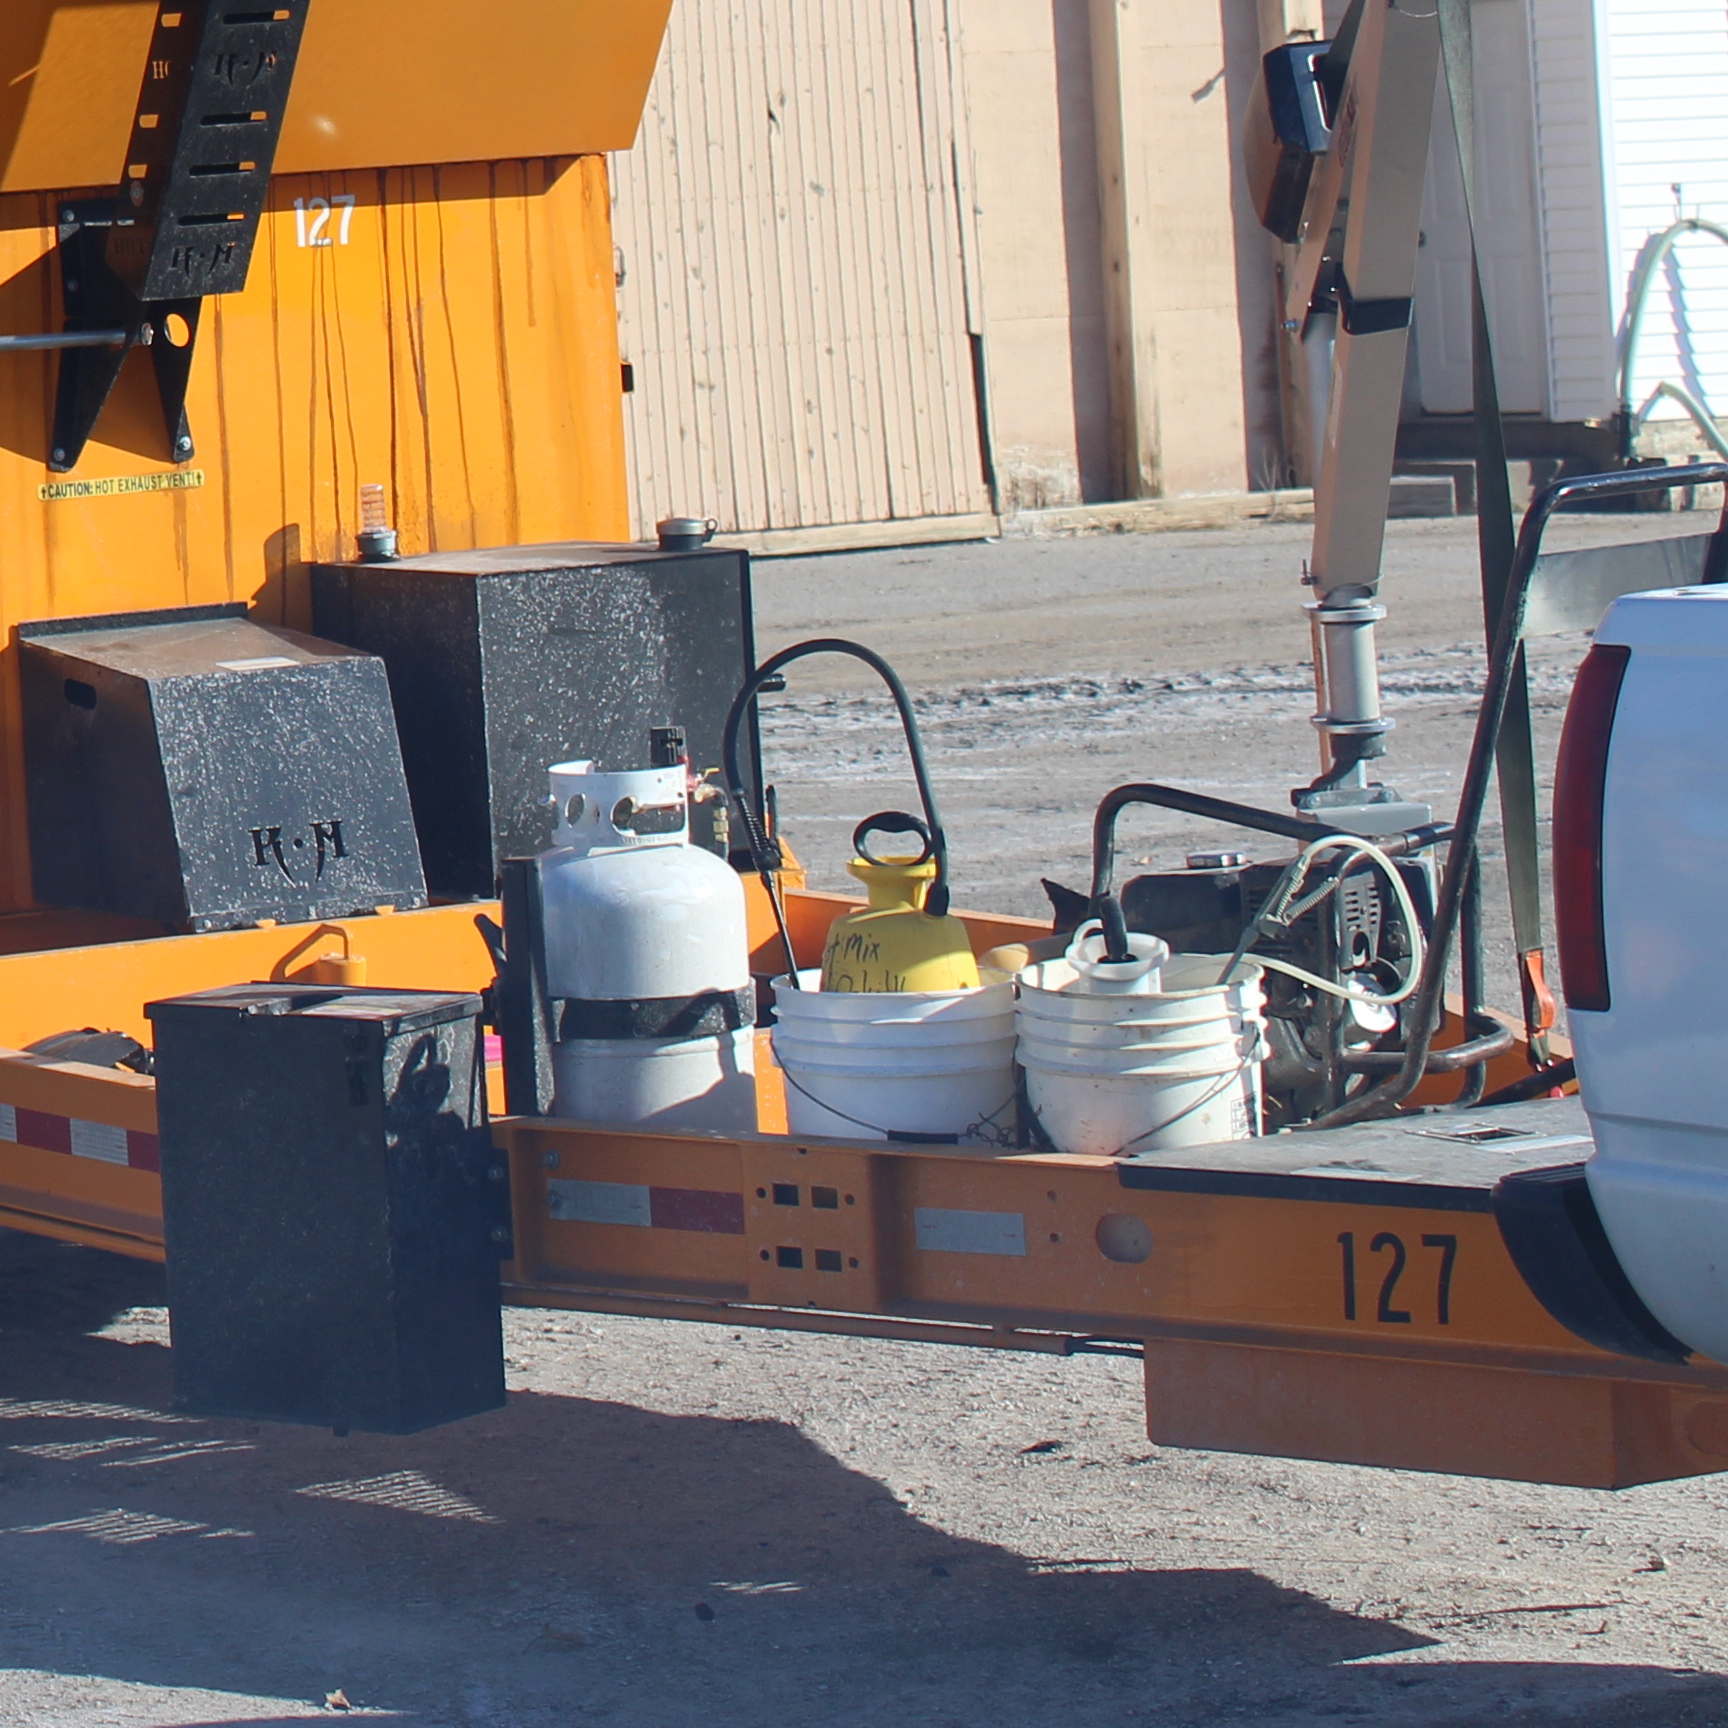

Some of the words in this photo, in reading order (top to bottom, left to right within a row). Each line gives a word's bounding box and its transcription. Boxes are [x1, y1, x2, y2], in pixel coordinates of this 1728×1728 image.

[293, 194, 356, 248] 127
[48, 481, 93, 499] CAUTION:
[95, 479, 115, 495] HOT
[118, 475, 163, 492] EXHAUST
[166, 472, 195, 488] VENT!
[843, 933, 881, 963] Mix
[1337, 1232, 1457, 1325] 127
